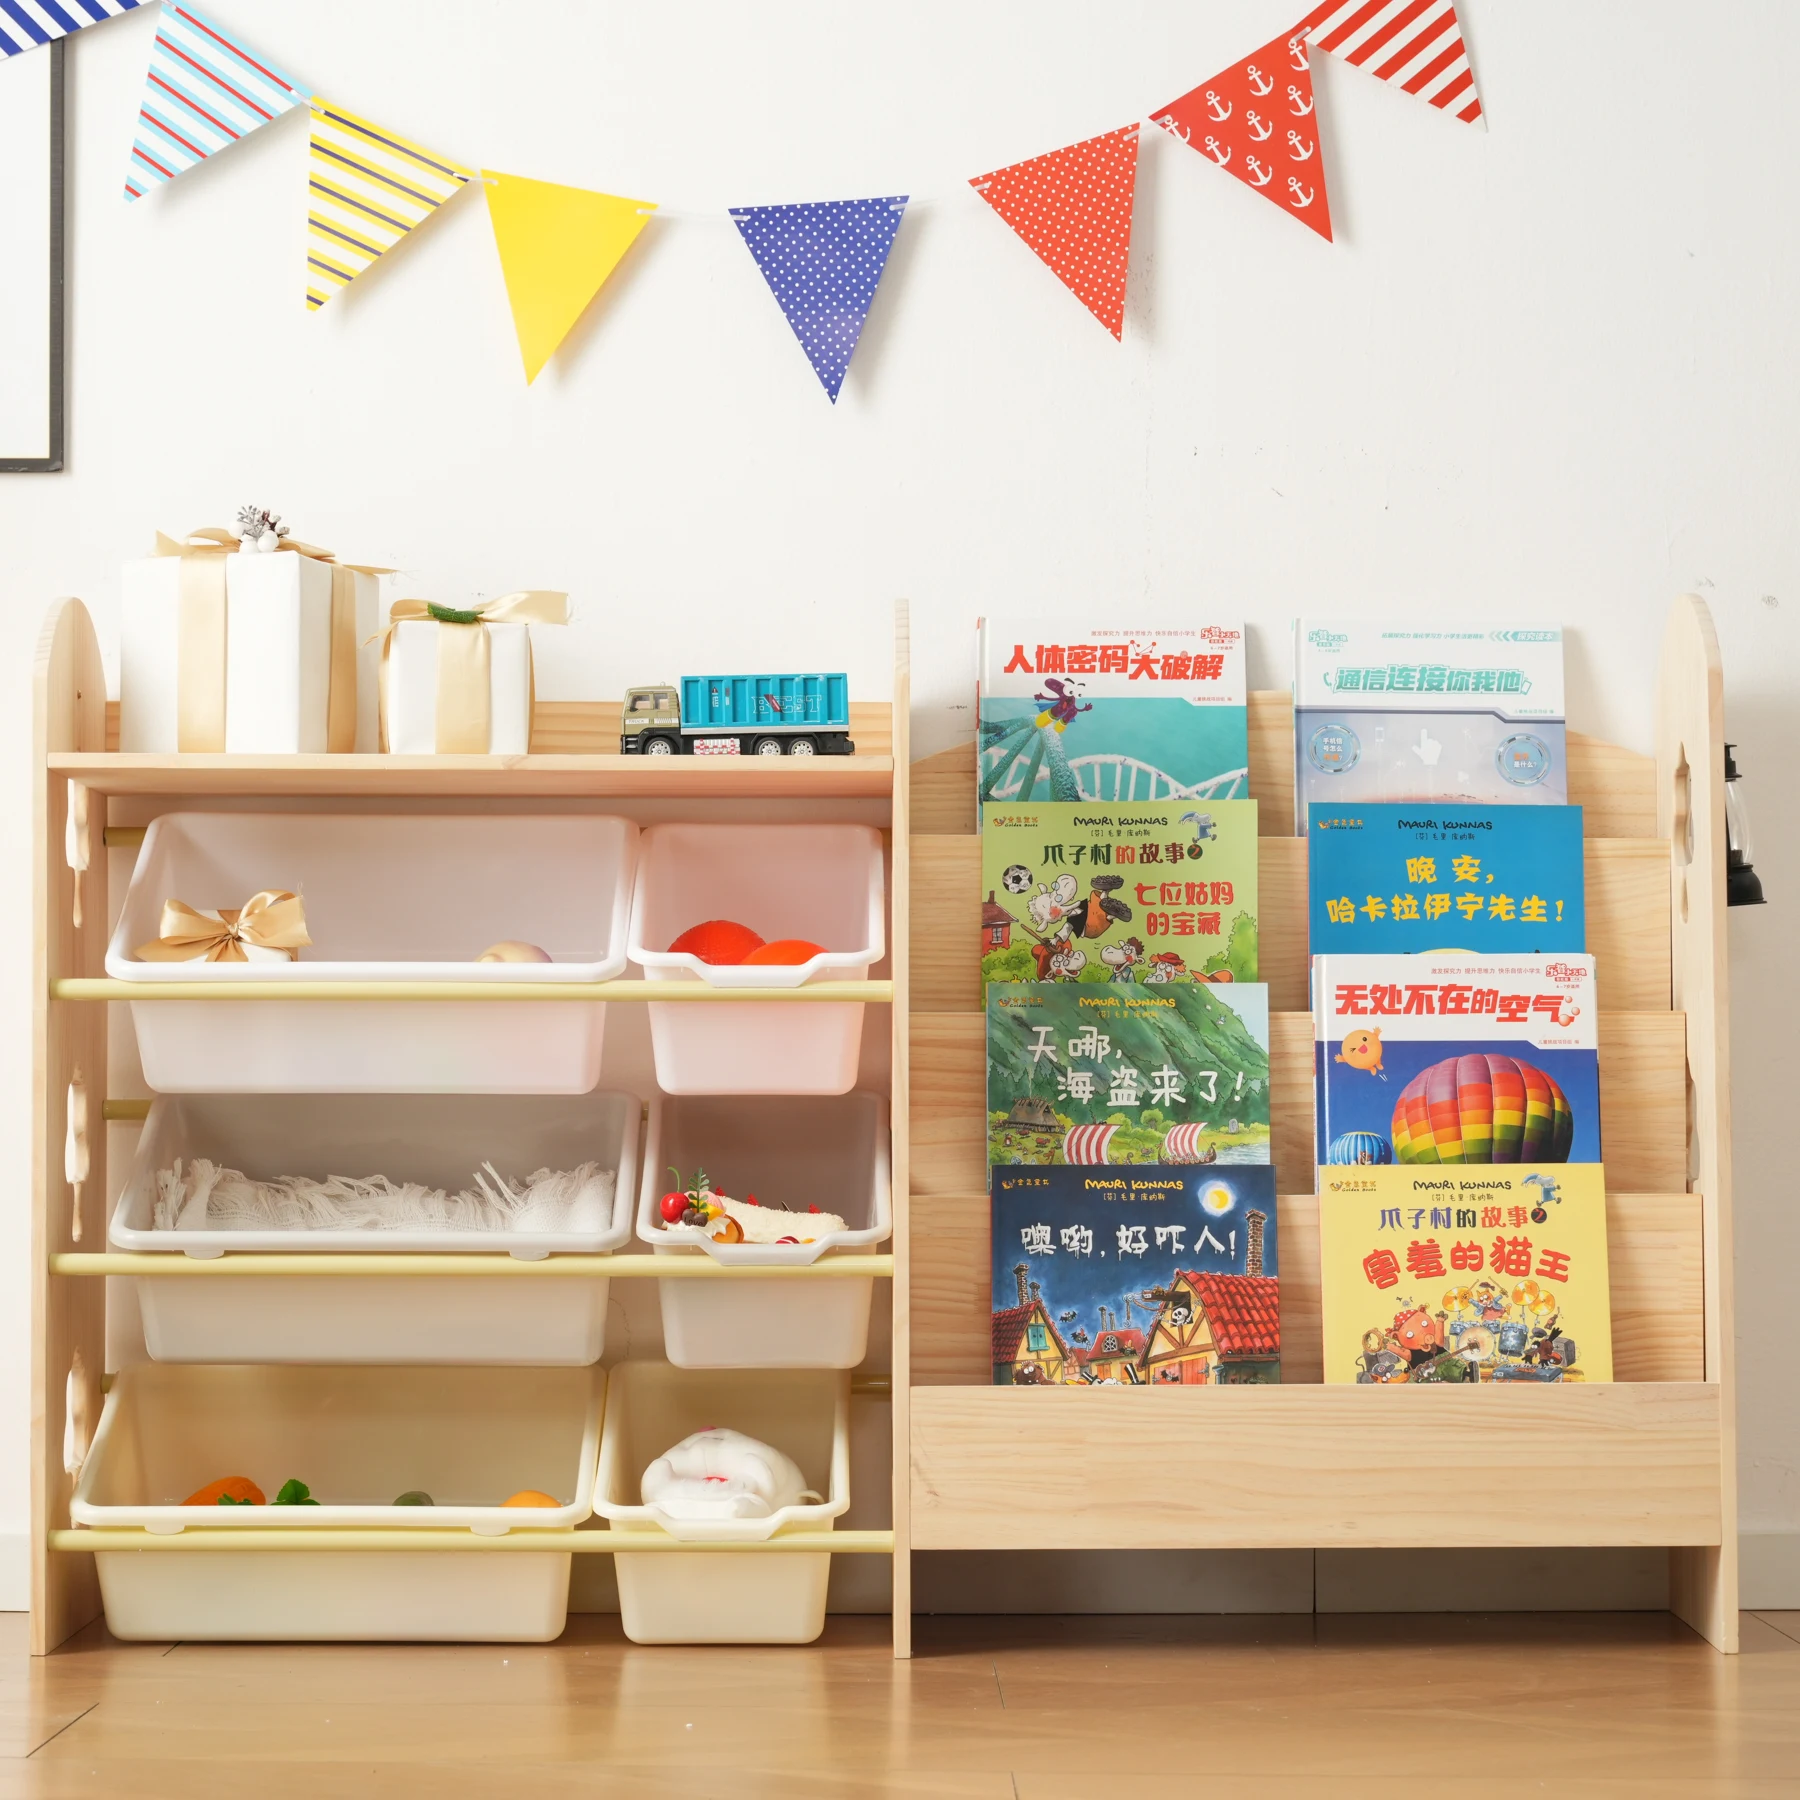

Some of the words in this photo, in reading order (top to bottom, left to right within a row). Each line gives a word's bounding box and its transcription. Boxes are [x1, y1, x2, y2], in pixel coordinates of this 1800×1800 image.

[1004, 644, 1224, 680] 人体密码大破解
[1334, 664, 1525, 695] 通信连接你我他
[1073, 816, 1114, 827] MAURI
[1118, 817, 1168, 827] KUNNAS
[1397, 819, 1439, 830] MAURI
[1442, 820, 1493, 831] KUNNAS
[1134, 882, 1234, 905] 七位姑妈
[1326, 892, 1564, 923] 哈卡拉伊宁先生！
[1147, 912, 1221, 936] 的宝藏
[1079, 997, 1120, 1008] MAURI
[1124, 998, 1176, 1008] KUNNAS
[1335, 983, 1575, 1023] 无处不在的空气
[1056, 1064, 1244, 1107] 海盗来了！
[1084, 1179, 1127, 1190] MAURI
[1131, 1180, 1184, 1191] KUNNAS
[1413, 1180, 1455, 1191] MAURI
[1459, 1181, 1512, 1191] KUNNAS
